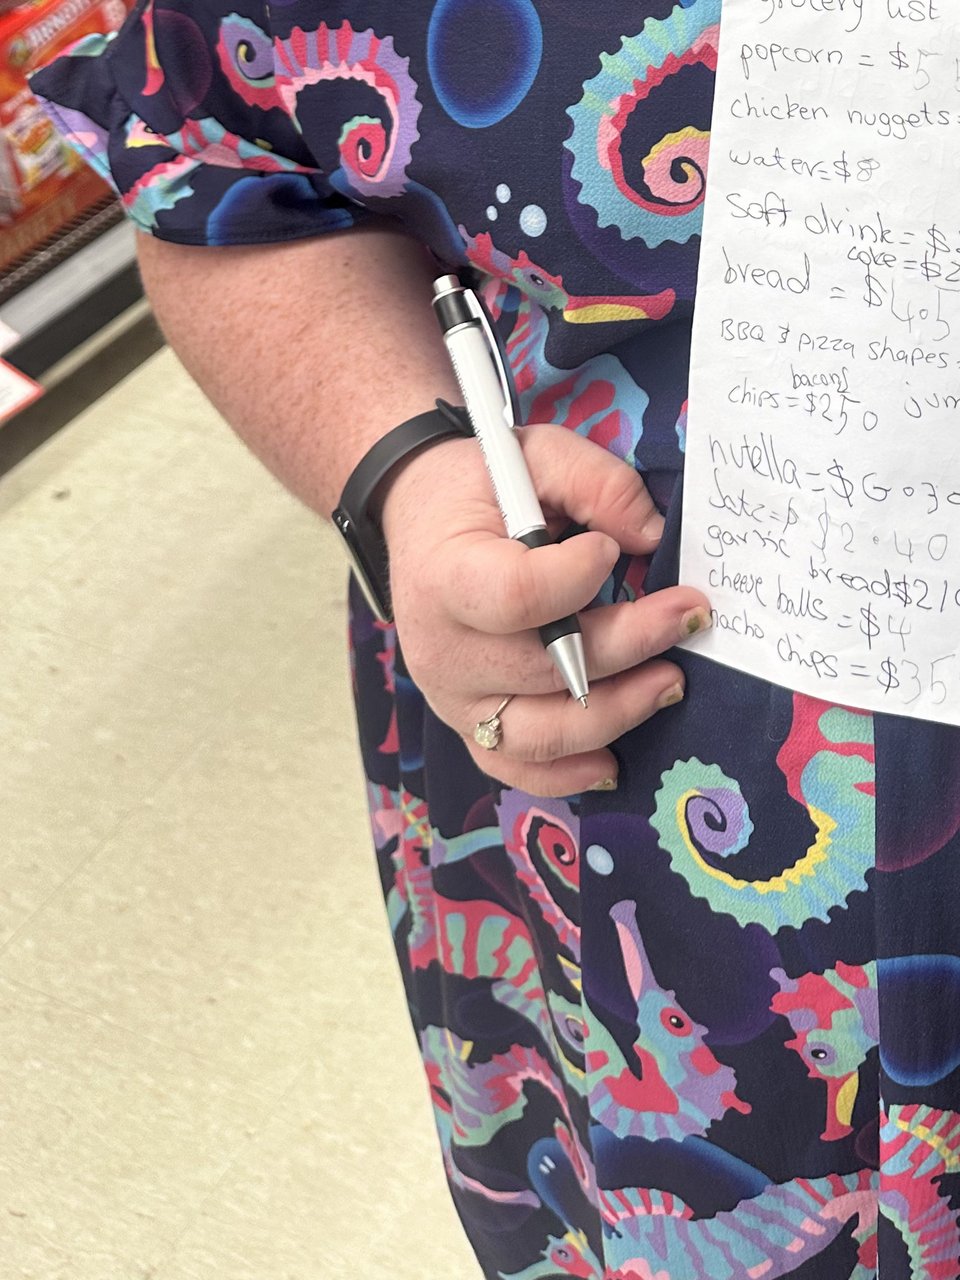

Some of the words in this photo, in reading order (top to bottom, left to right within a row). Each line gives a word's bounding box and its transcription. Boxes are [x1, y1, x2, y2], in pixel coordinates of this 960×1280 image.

[740, 42, 843, 80] popcorn
[729, 94, 829, 121] chicken
[804, 202, 894, 244] drink
[722, 246, 810, 294] bread
[721, 318, 766, 343] BBQ
[708, 432, 801, 490] nutella
[777, 574, 828, 621] balls
[710, 608, 765, 639] nacho
